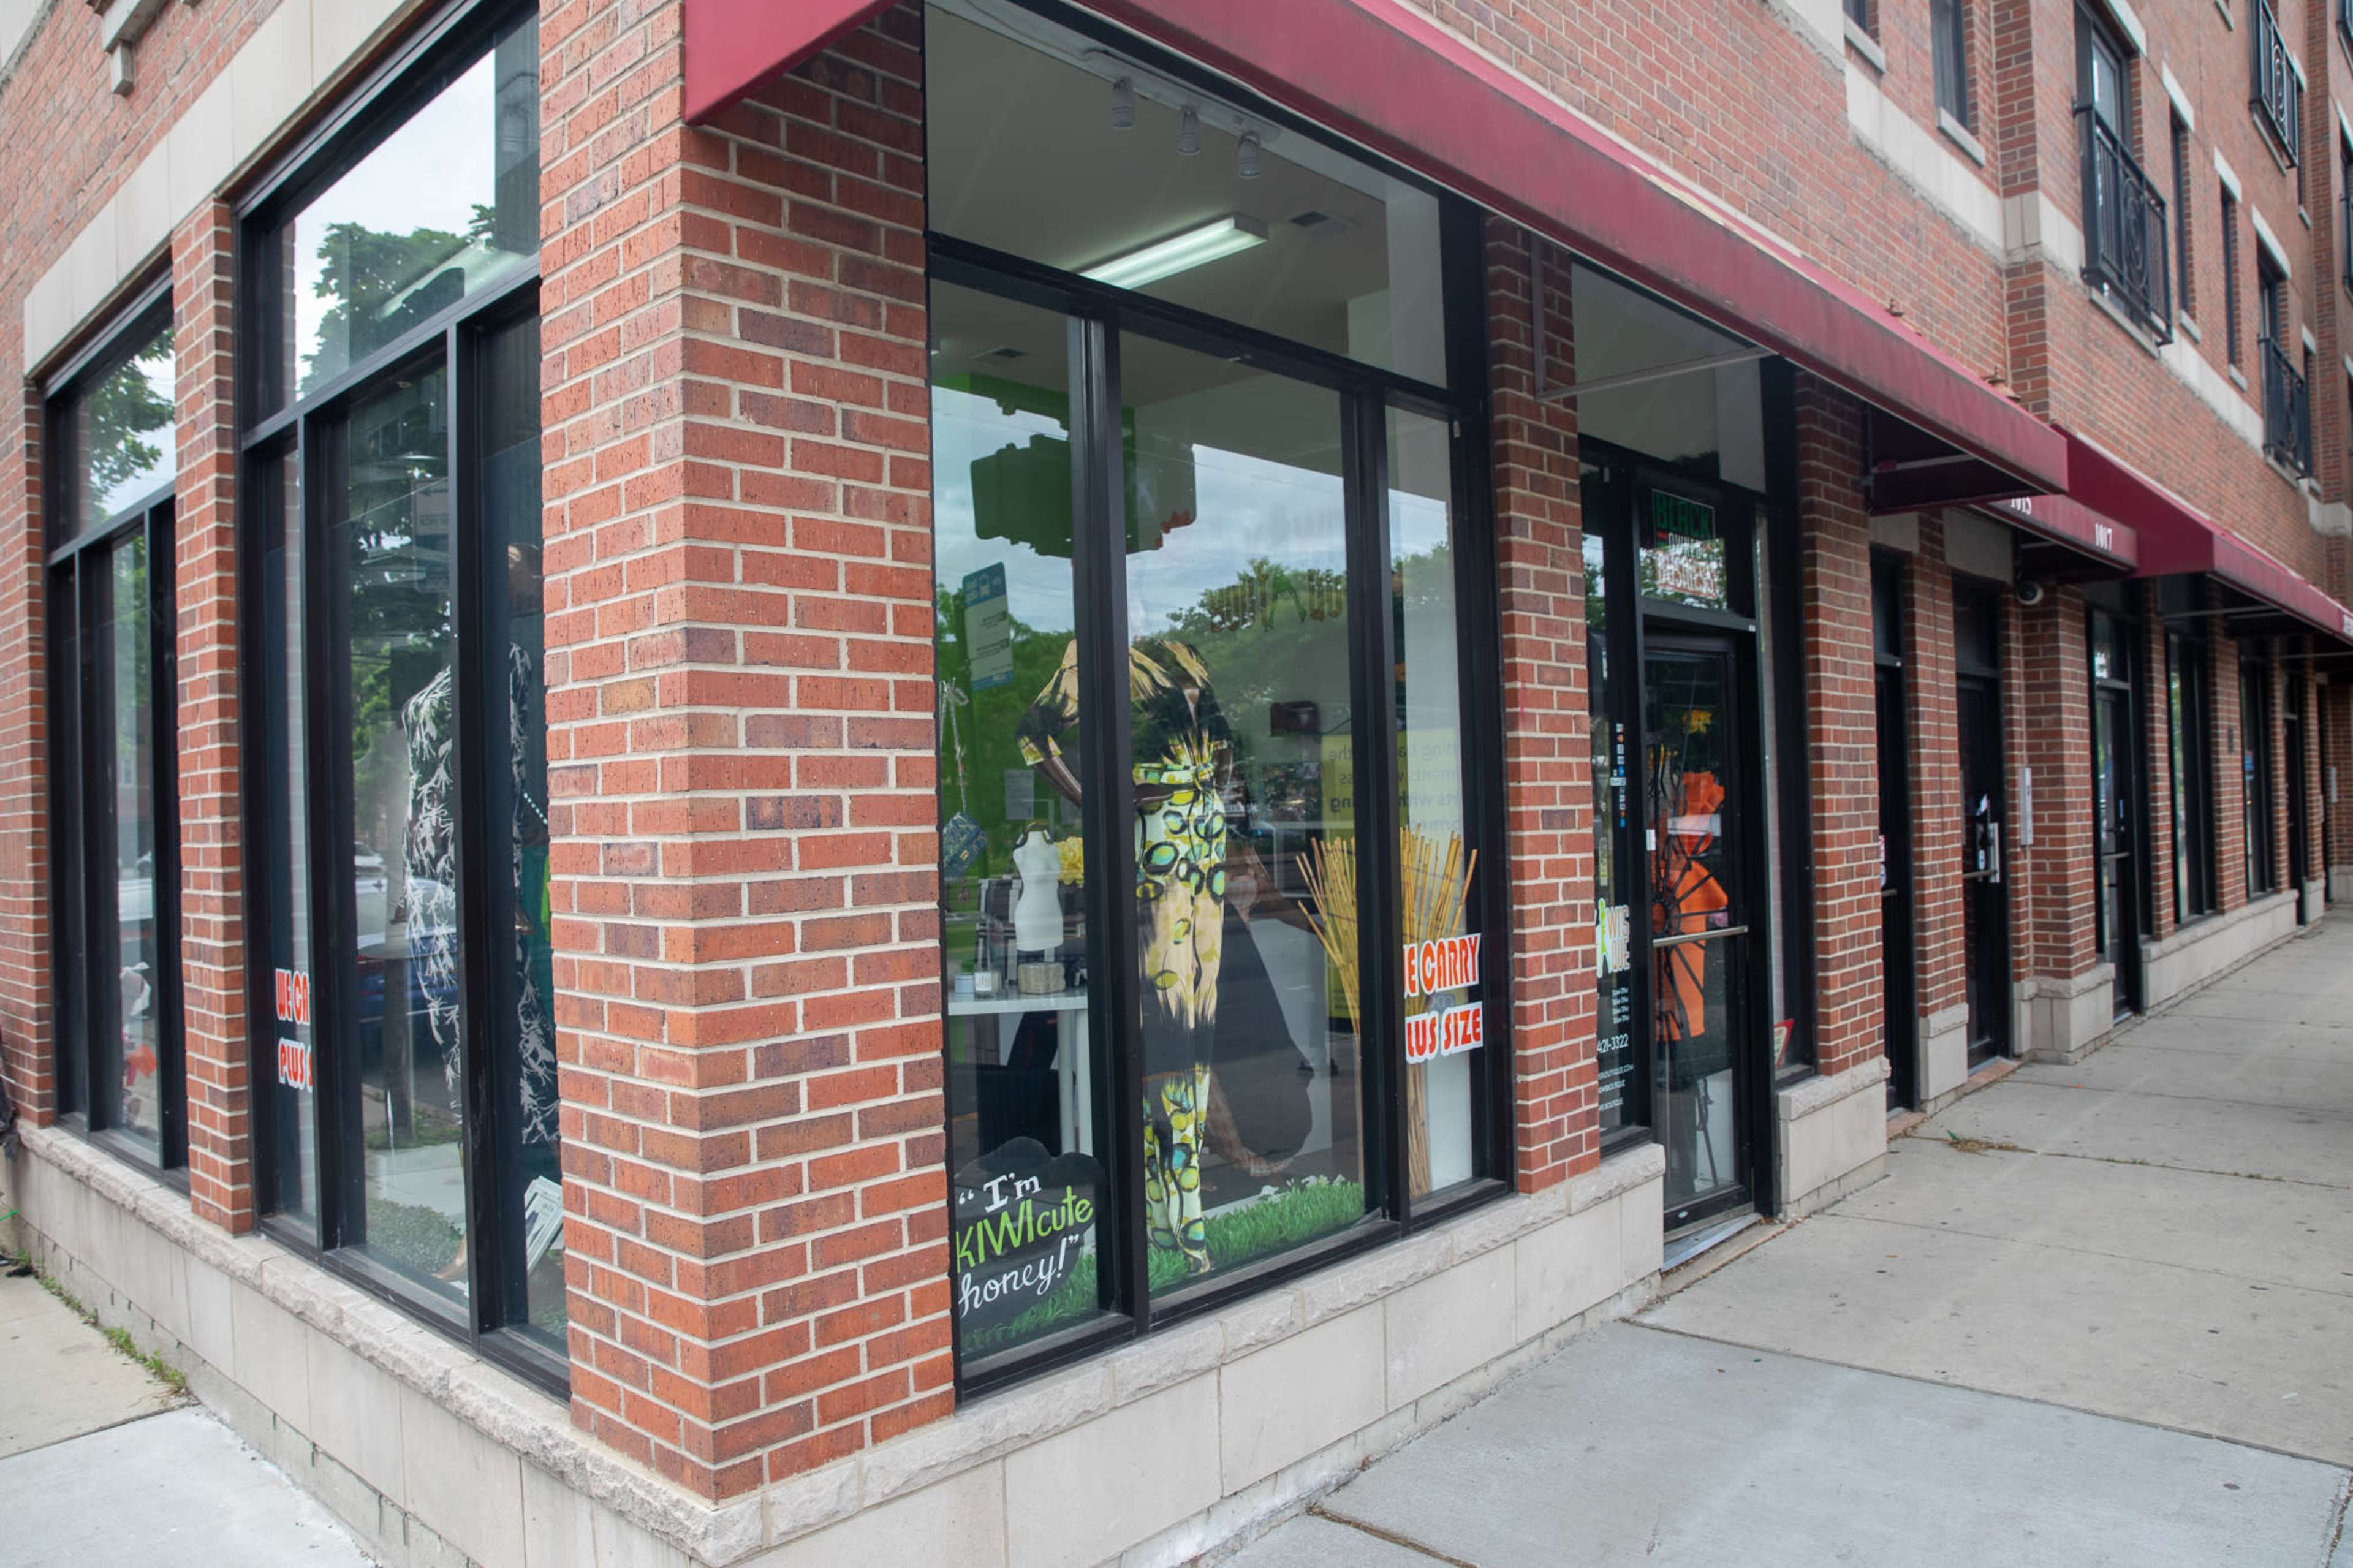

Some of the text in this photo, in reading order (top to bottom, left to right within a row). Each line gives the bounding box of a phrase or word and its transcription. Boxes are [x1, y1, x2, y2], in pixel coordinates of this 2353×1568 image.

[1656, 492, 1713, 541] BLACK
[2095, 523, 2112, 551] 1017
[1403, 936, 1478, 994] E CARRY
[277, 971, 309, 1023] WE CA
[1406, 1008, 1480, 1058] LUS SIZE
[280, 1043, 305, 1085] PLUS
